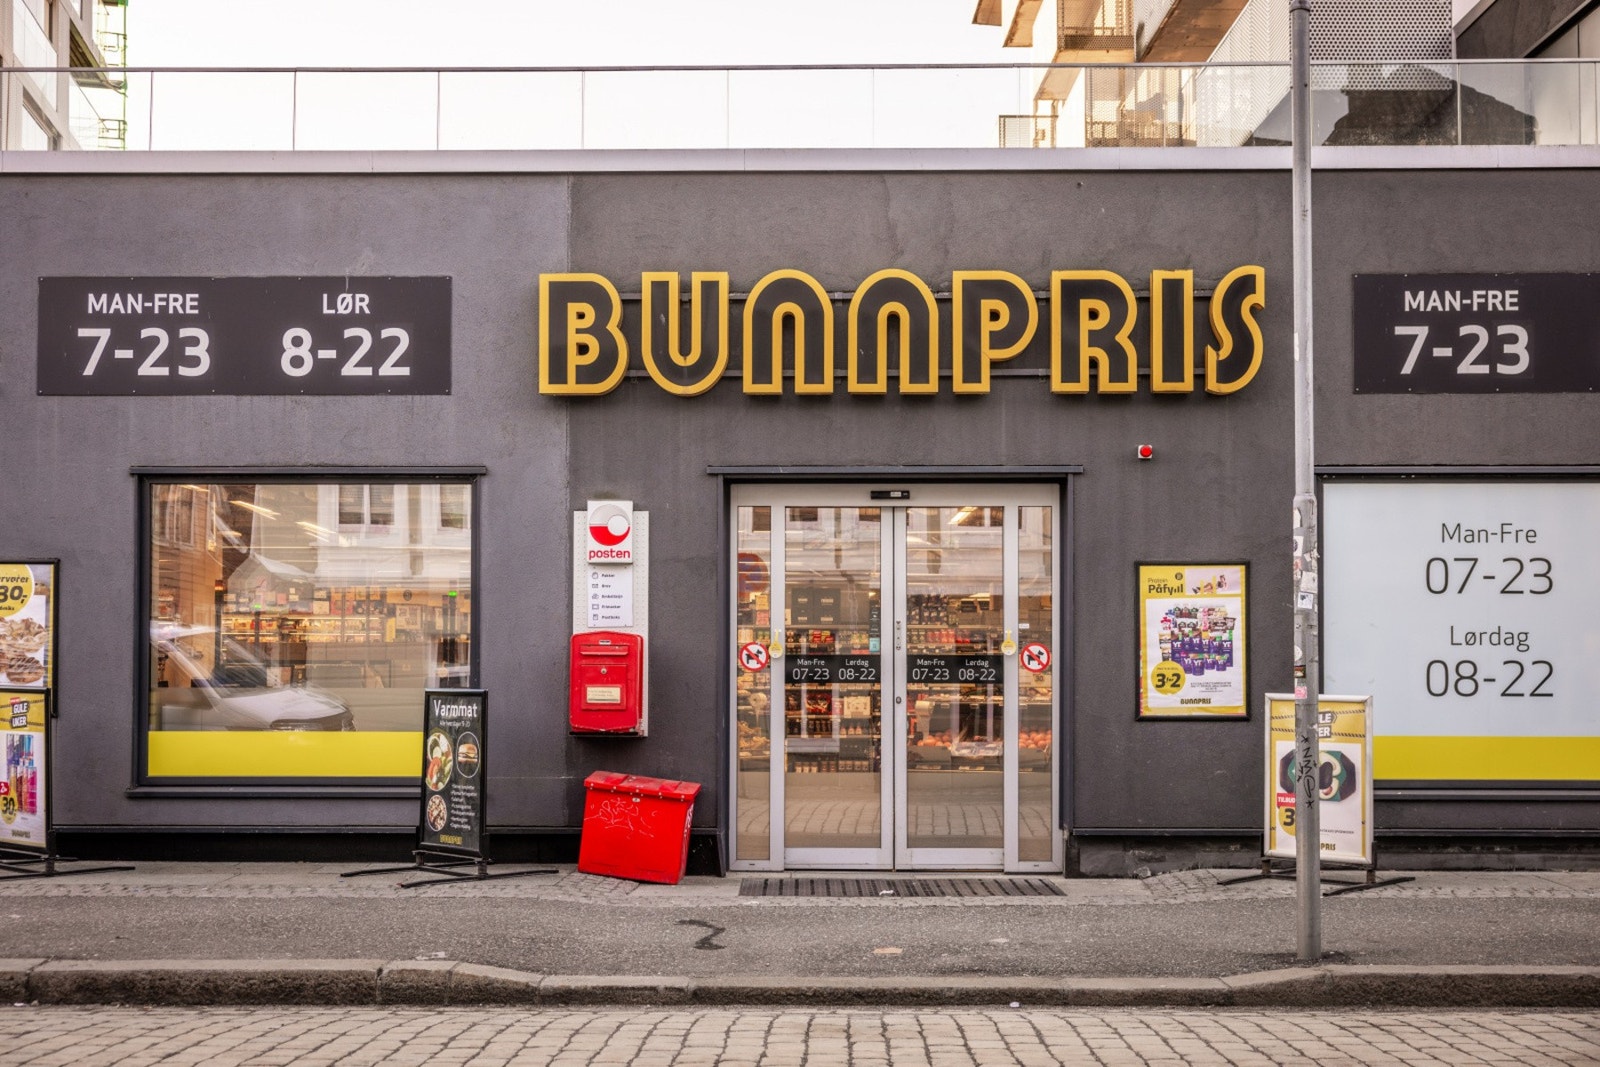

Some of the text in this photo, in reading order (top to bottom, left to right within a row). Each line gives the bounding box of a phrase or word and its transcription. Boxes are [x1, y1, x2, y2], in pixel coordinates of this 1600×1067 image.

[87, 293, 199, 314] MAN-FRE
[322, 293, 370, 314] LØR
[1404, 290, 1519, 312] MAN-FRE
[538, 266, 1266, 396] BUNNPRIS
[77, 327, 211, 377] 7-23
[280, 327, 411, 377] 8-22
[1394, 324, 1530, 375] 7-23
[1441, 522, 1537, 544] Man-Fre
[588, 548, 631, 560] posten
[1425, 557, 1553, 595] 07-23
[1450, 625, 1530, 653] Lørdag
[797, 658, 825, 666] Man-Fre
[845, 658, 869, 667] Lørdag
[917, 658, 945, 666] Man-Fre
[965, 658, 989, 668] Lørdag
[792, 668, 830, 680] 07-23
[838, 668, 876, 680] 08-22
[912, 668, 950, 680] 07-23
[958, 668, 996, 680] 08-22
[1155, 673, 1166, 688] 3
[1170, 673, 1181, 688] 2
[1425, 659, 1554, 698] 08-22
